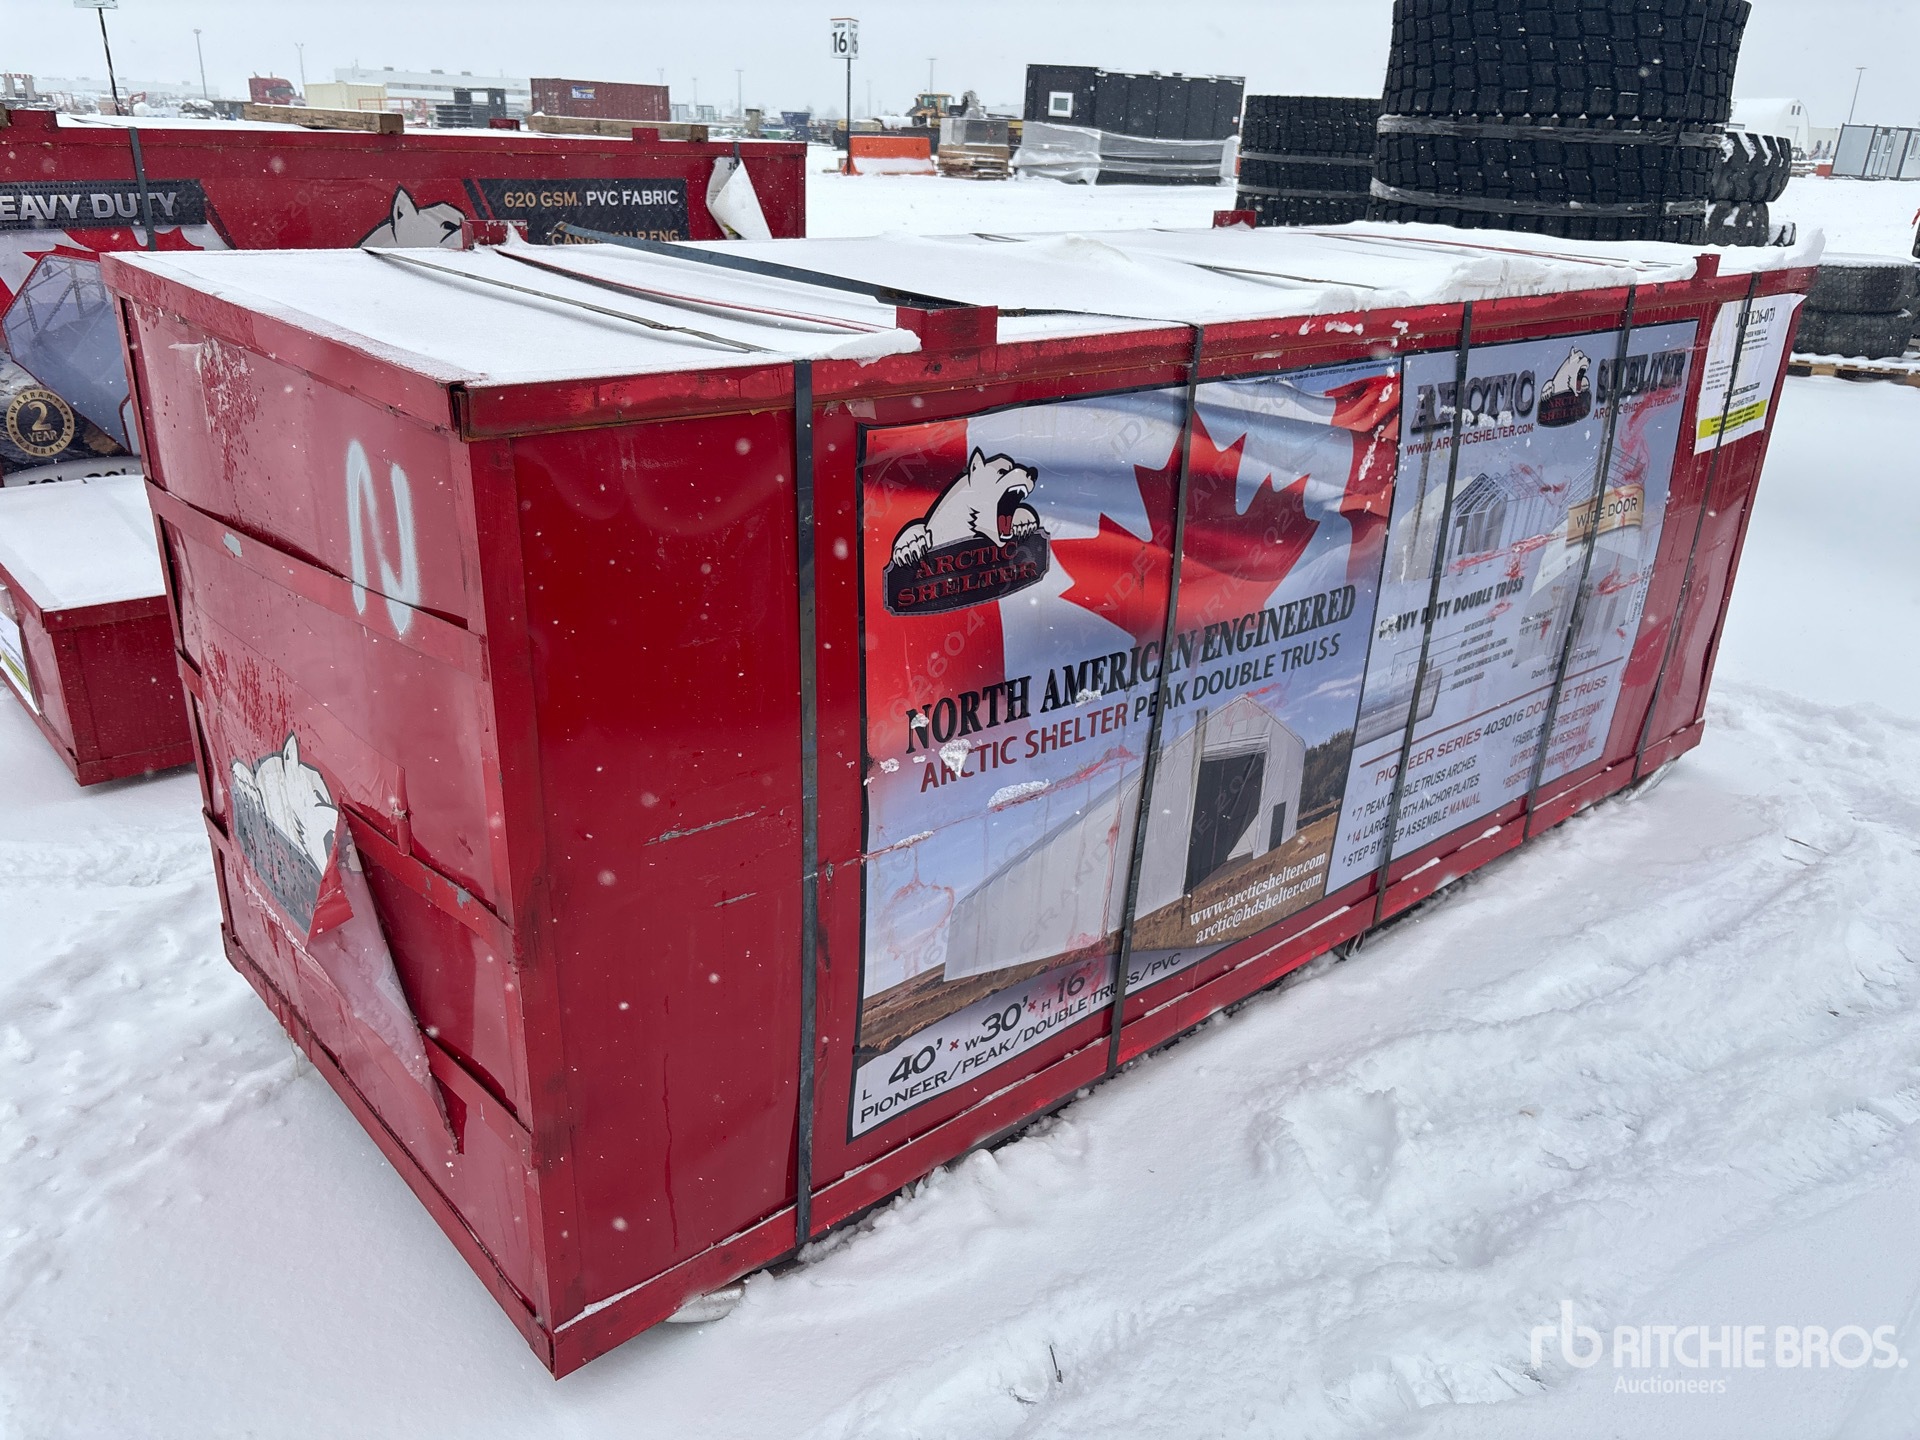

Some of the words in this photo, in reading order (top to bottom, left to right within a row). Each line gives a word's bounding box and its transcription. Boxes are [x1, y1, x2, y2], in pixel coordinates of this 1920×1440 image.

[832, 31, 848, 53] 16
[90, 191, 177, 219] DUTY
[504, 192, 537, 208] 620
[540, 191, 582, 207] GSM.
[586, 190, 618, 206] PVC
[622, 189, 679, 205] FABRIC
[1596, 349, 1686, 404] SELTER
[27, 430, 58, 442] YEAR
[28, 400, 52, 431] 2
[346, 439, 420, 635] N
[1576, 506, 1605, 529] WIDE
[1607, 497, 1638, 519] DOOR
[897, 561, 1038, 608] SHELTER
[915, 541, 1018, 579] ARCTIC
[1377, 610, 1418, 640] AVY
[1420, 600, 1451, 624] DTY
[1453, 586, 1493, 614] DOUBLE
[1495, 575, 1525, 600] TRUSS
[906, 676, 1031, 754] NORTH
[1200, 584, 1356, 663] ENGINEERED
[1025, 703, 1129, 758] SHELTER
[1134, 680, 1188, 722] PEAK
[1193, 653, 1276, 701] DOUBLE
[1281, 633, 1341, 672] TRUSS
[1375, 748, 1435, 785] PIOEER
[1437, 728, 1482, 757] SERIES
[1483, 709, 1525, 737] 403016
[1525, 689, 1572, 719] DOULE
[1574, 675, 1608, 698] TRUSS
[1362, 816, 1390, 839] LARGE
[1394, 802, 1418, 822] ARTH
[1419, 787, 1452, 810] ANCHOR
[1452, 773, 1480, 796] PLATES
[1364, 795, 1389, 818] PEAK
[1387, 780, 1420, 806] DBLE
[1420, 771, 1450, 790] TRUSS
[1446, 755, 1477, 777] ARCHES
[1370, 839, 1383, 853] BY
[1381, 828, 1405, 848] SEP
[1405, 808, 1448, 839] ASSEMBLE
[1448, 792, 1480, 815] MANUAL
[1189, 853, 1326, 926] www.arcticshelter.com
[1195, 872, 1323, 944] arctic@hdshelter.com
[888, 1037, 943, 1085] 40'
